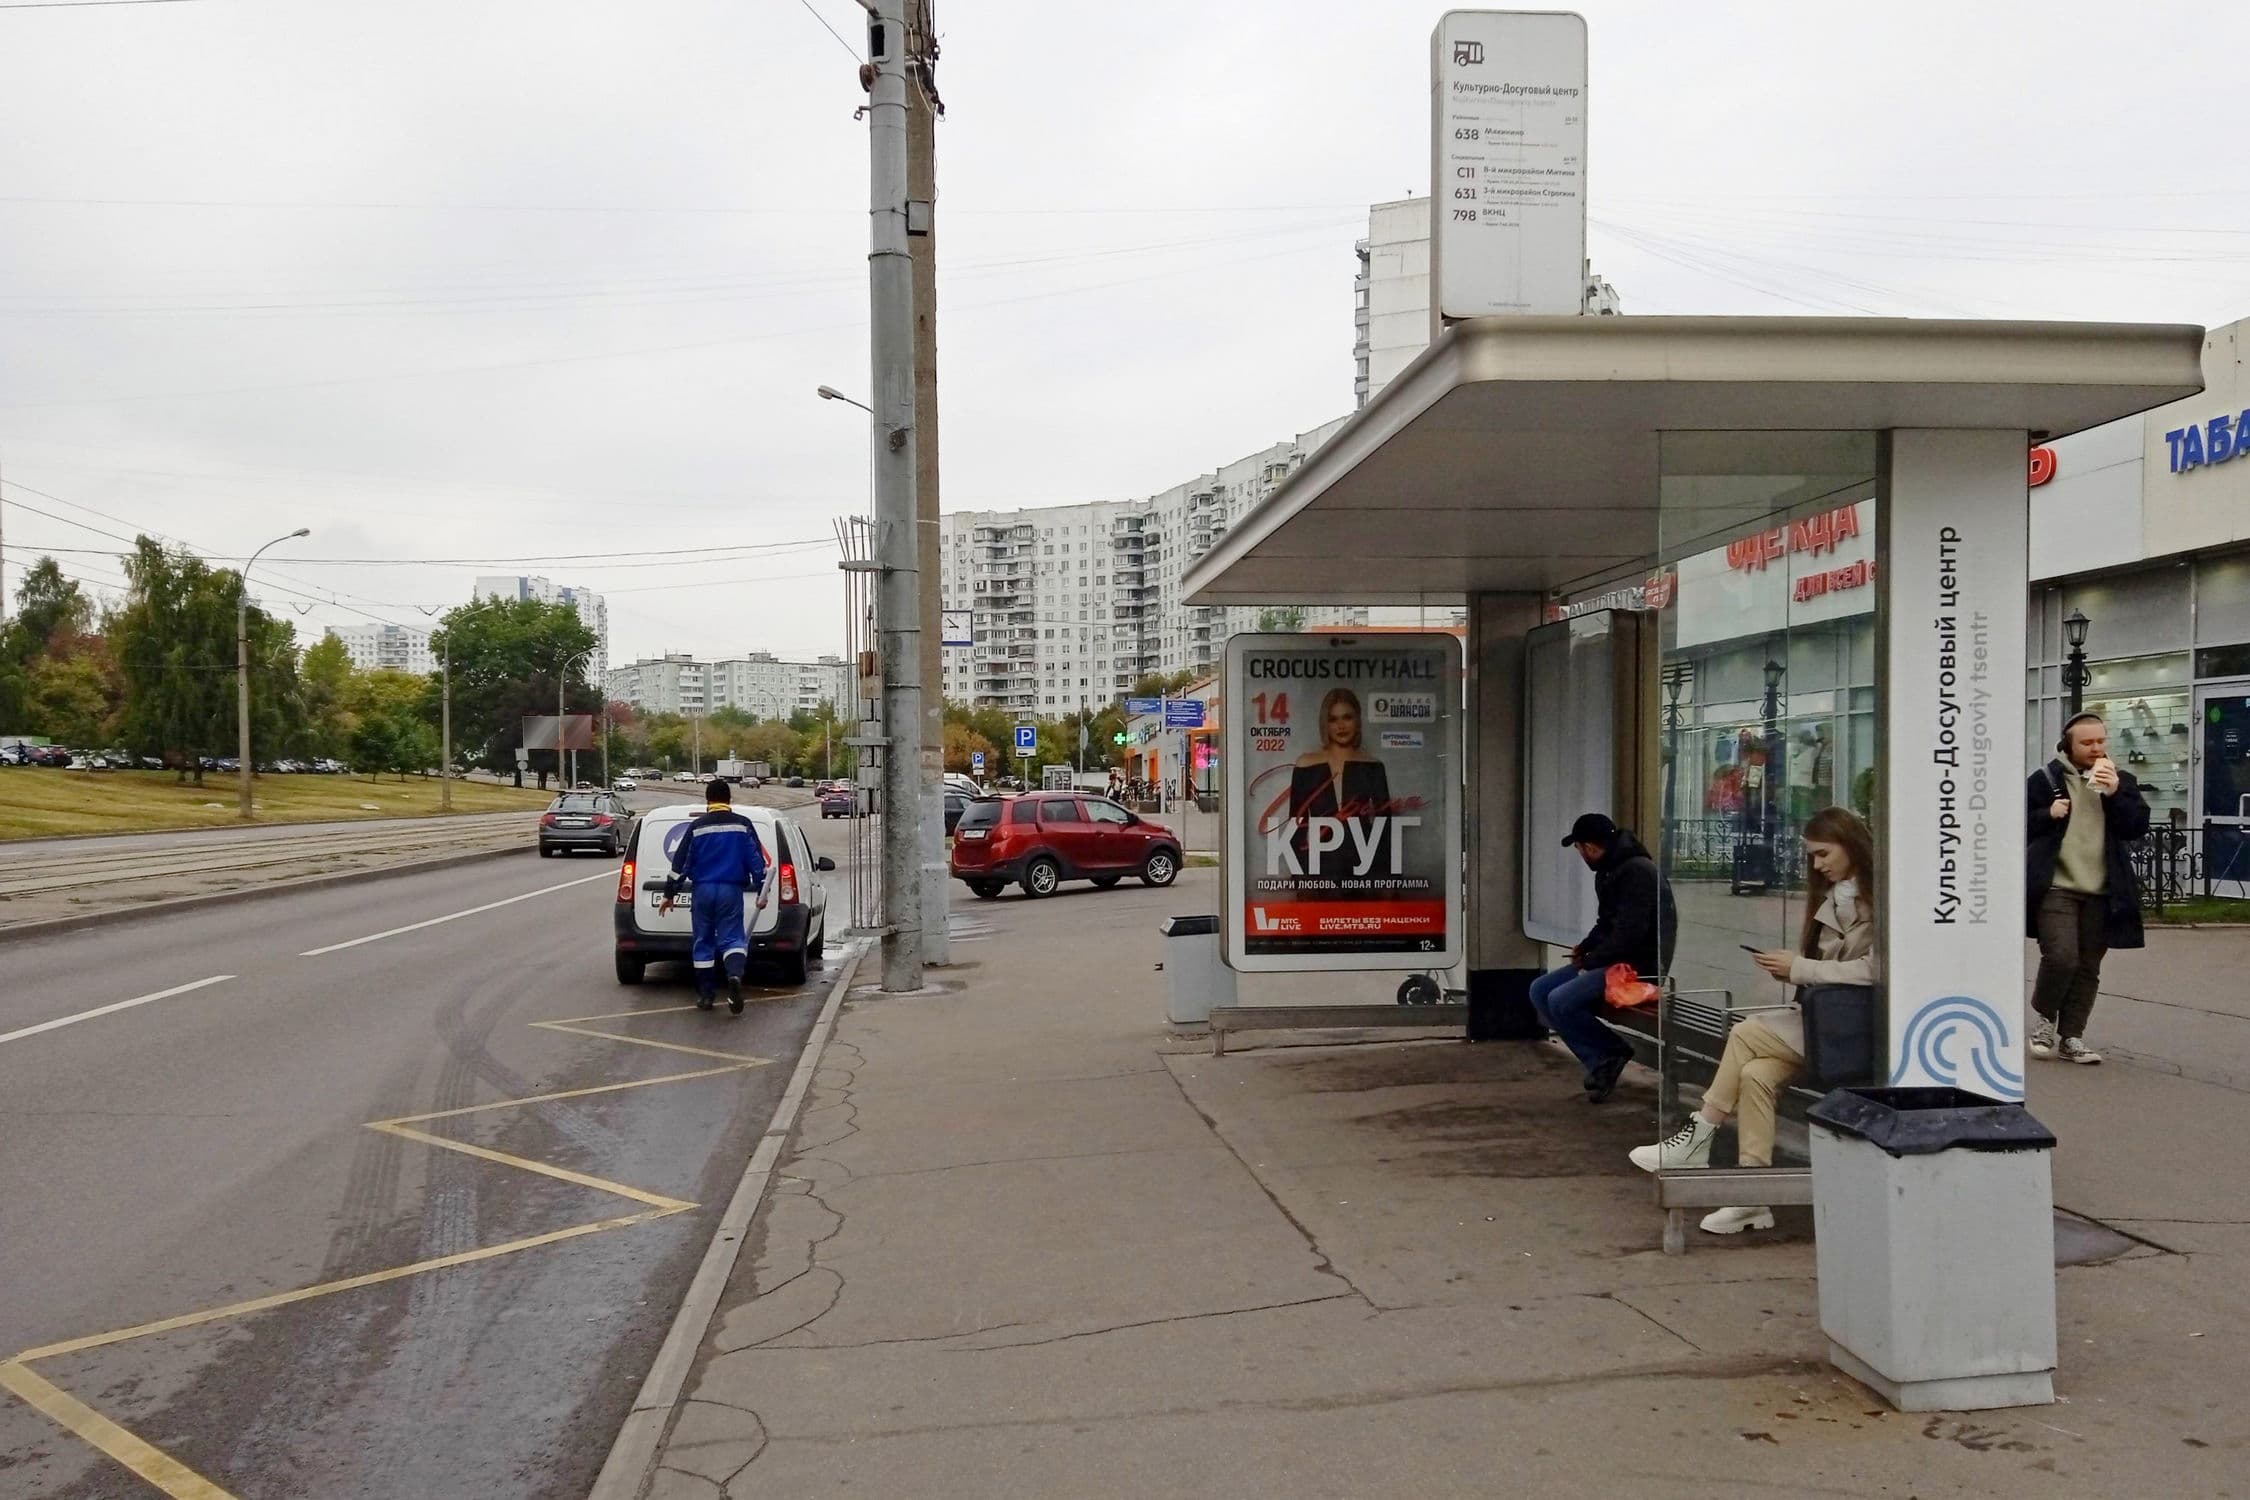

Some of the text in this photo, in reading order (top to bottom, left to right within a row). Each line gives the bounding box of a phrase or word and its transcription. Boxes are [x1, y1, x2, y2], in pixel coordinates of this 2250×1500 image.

[1453, 81, 1579, 98] Культурно-Досуговый центр
[1455, 127, 1480, 140] 638
[1498, 167, 1545, 176] микрорайон
[1454, 187, 1478, 200] 631
[1497, 188, 1541, 197] микрорайон
[1453, 209, 1477, 221] 798
[1249, 658, 1437, 679] CROCUS CITY HALL
[1252, 692, 1290, 724] 14
[1933, 526, 1961, 924] Культурно-Досуговый центр
[1250, 727, 1291, 737] ОКТЯБРЯ
[1256, 739, 1285, 751] 2022
[1968, 611, 1992, 924] Kulturno-Dosugoviy tsentr
[1267, 816, 1421, 876] КРУГ
[1257, 878, 1429, 891] ПОДАРИ ЛЮБОВЬ. НОВАЯ ПРОГРАММА
[1419, 940, 1436, 951] 12+
